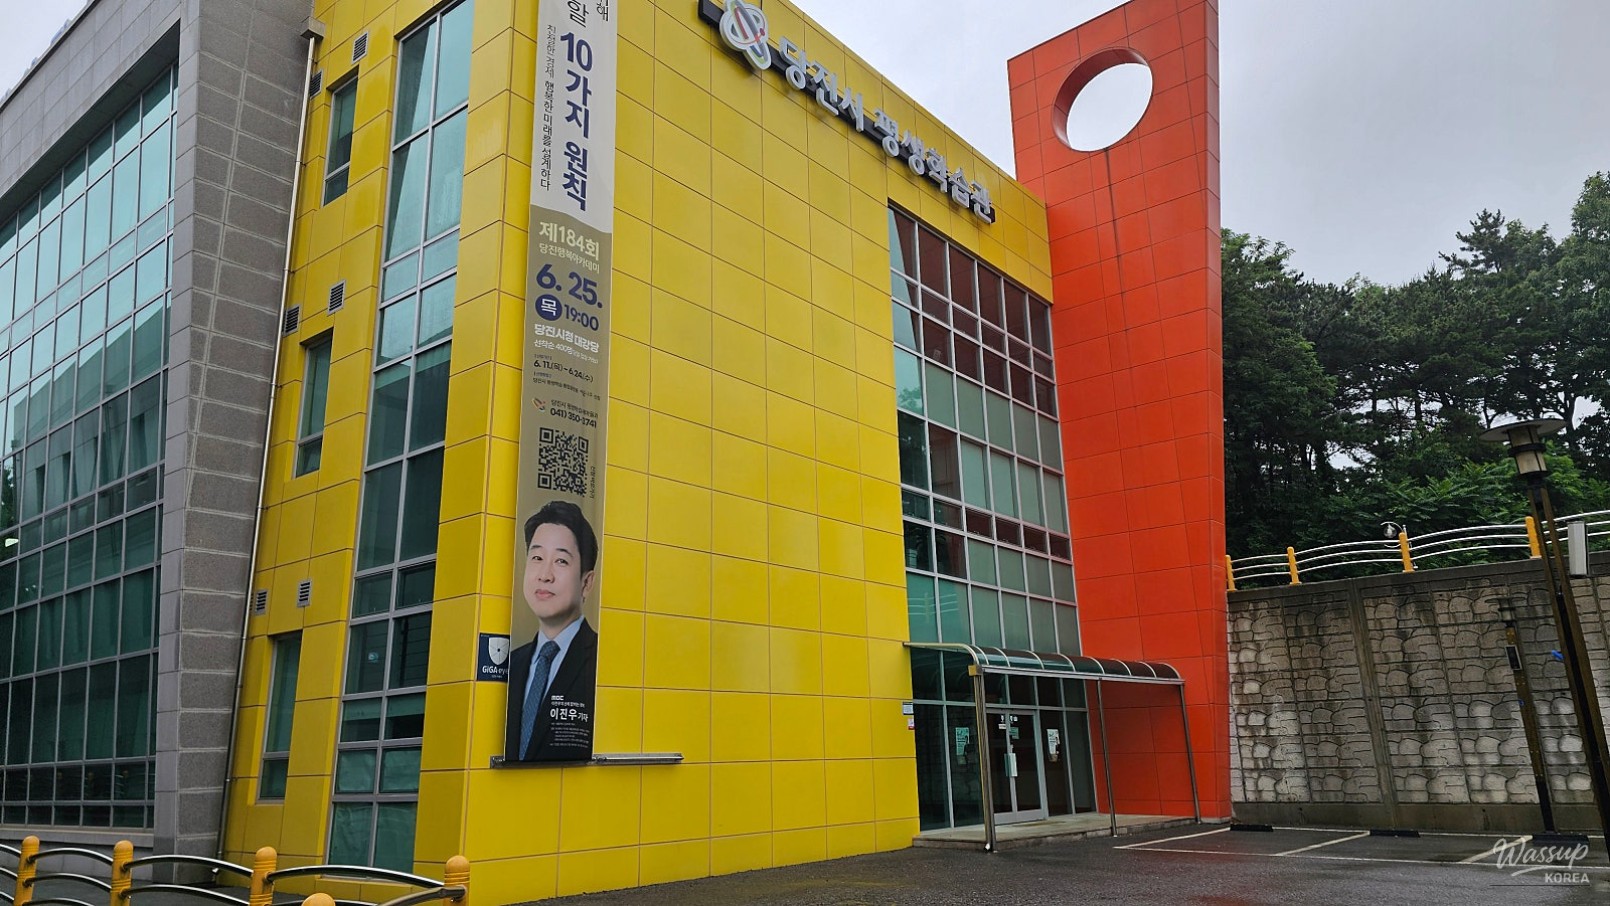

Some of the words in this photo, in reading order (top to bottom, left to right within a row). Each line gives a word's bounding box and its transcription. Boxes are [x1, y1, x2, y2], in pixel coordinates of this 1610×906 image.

[560, 31, 593, 139] 10가지
[779, 35, 865, 133] 당진시
[873, 107, 993, 224] 평생학습관
[562, 140, 588, 211] 원칙
[539, 221, 599, 261] 제184회
[536, 264, 562, 291] 6.
[568, 271, 603, 309] 25.
[534, 323, 574, 343] 당진시청
[541, 298, 557, 317] 목
[564, 304, 599, 331] 19:00
[549, 708, 577, 721] 이진우
